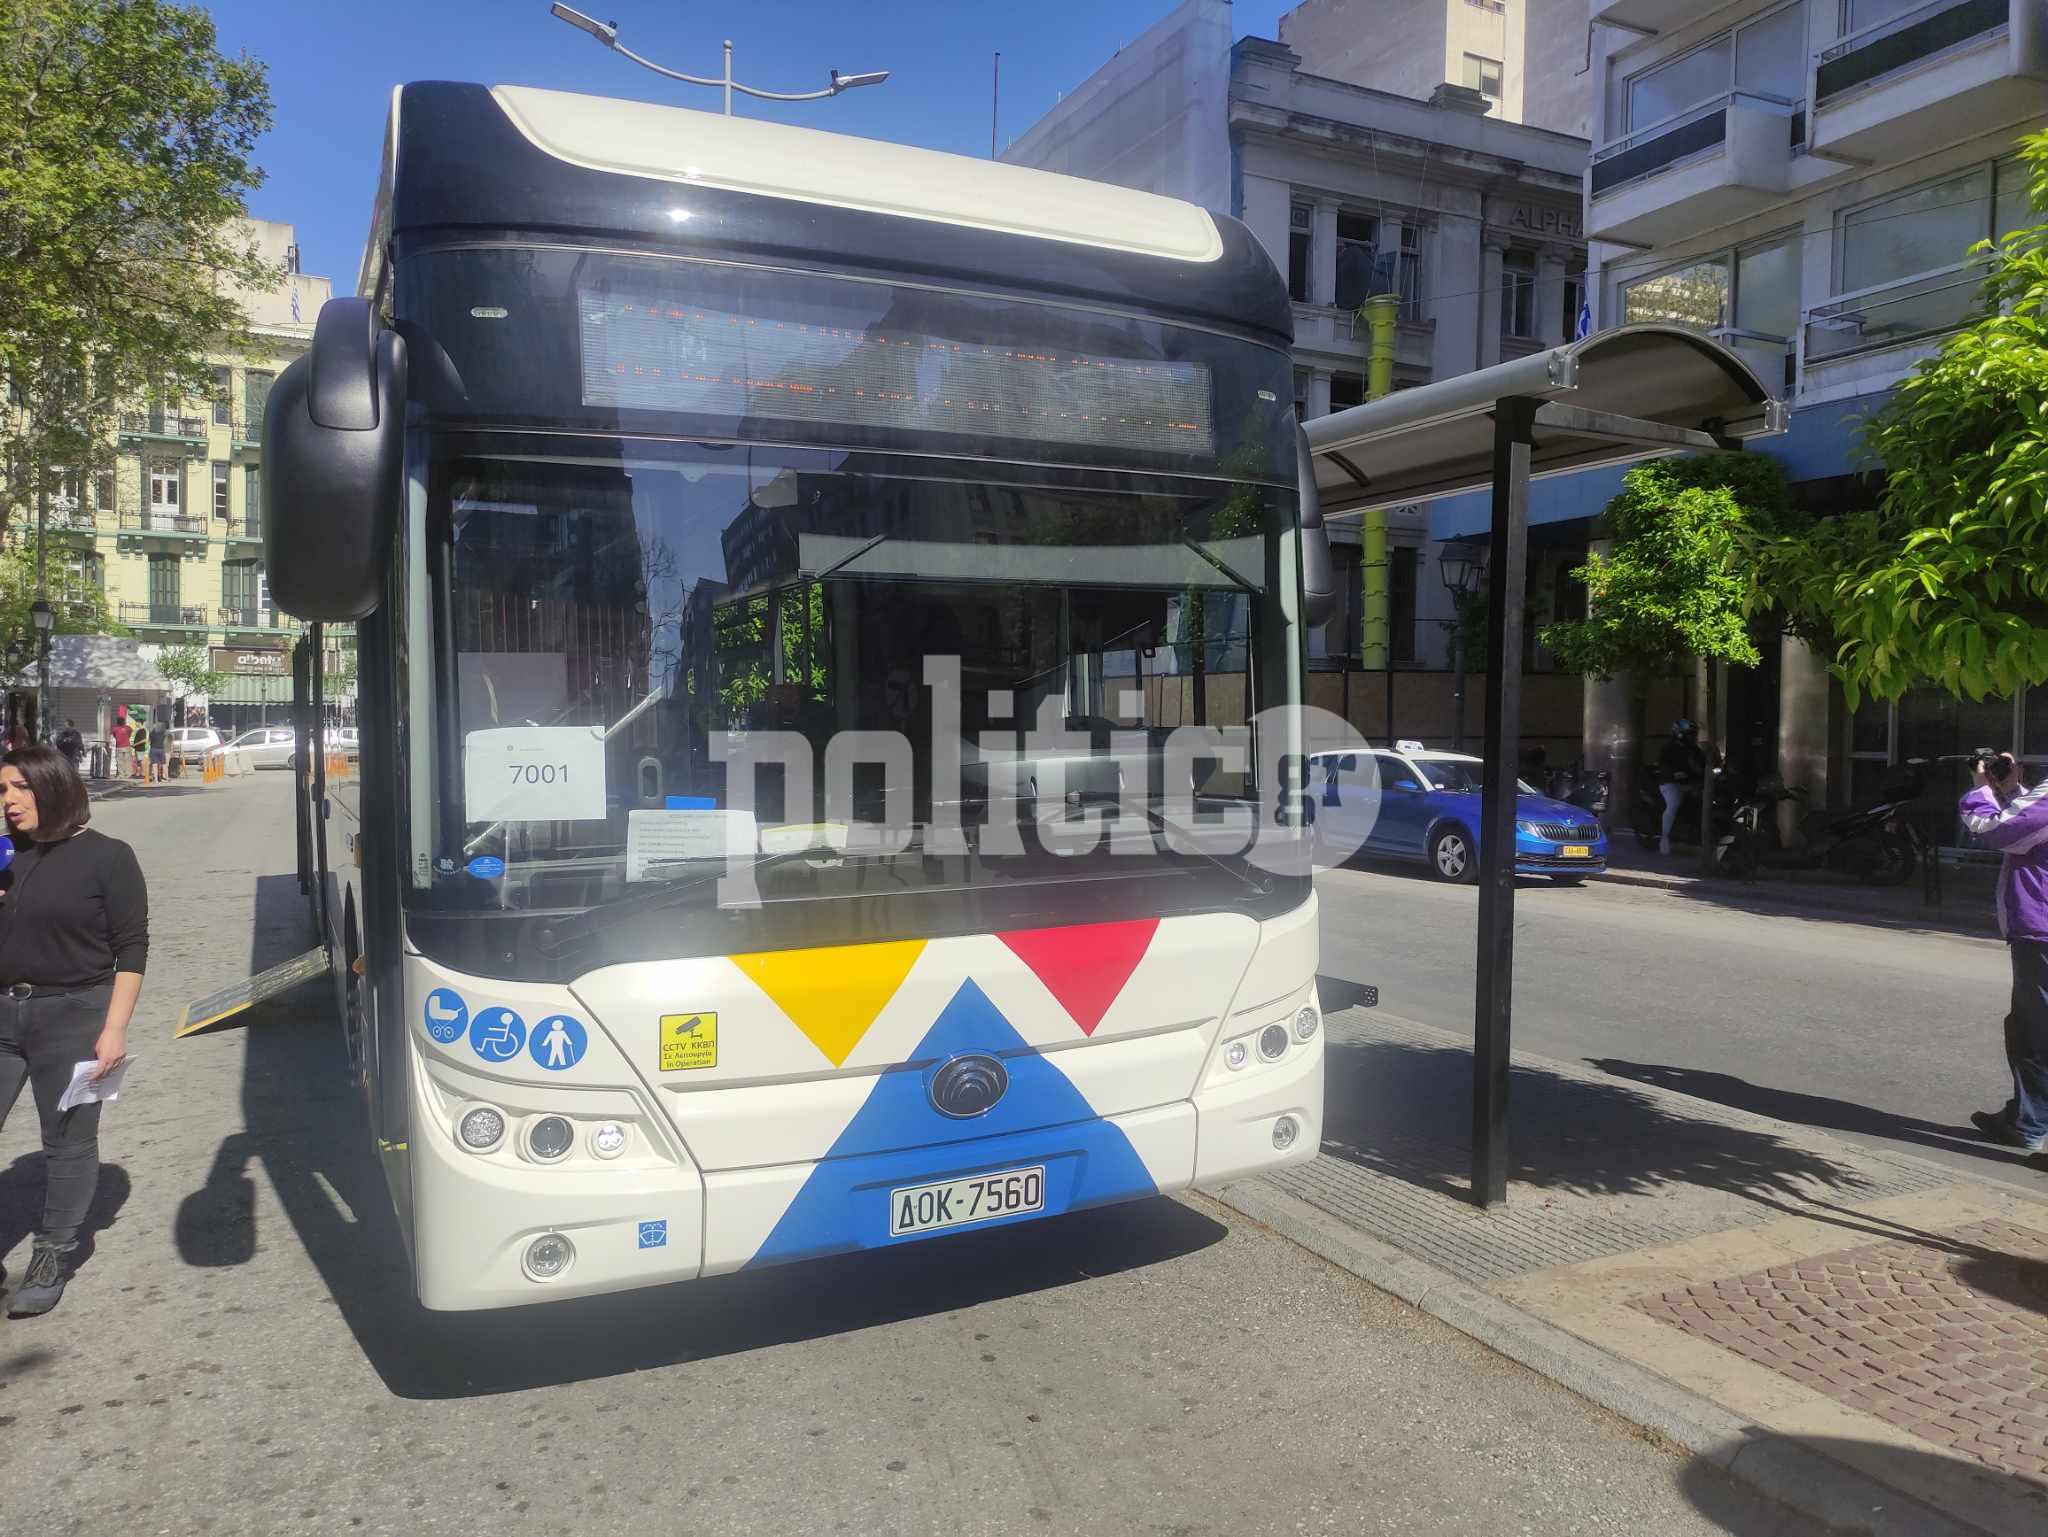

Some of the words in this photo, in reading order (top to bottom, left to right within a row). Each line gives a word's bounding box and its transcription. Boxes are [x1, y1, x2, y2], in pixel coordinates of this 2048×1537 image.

[508, 764, 568, 784] 7001
[663, 1042, 687, 1052] CCTV
[675, 1059, 711, 1067] Operation
